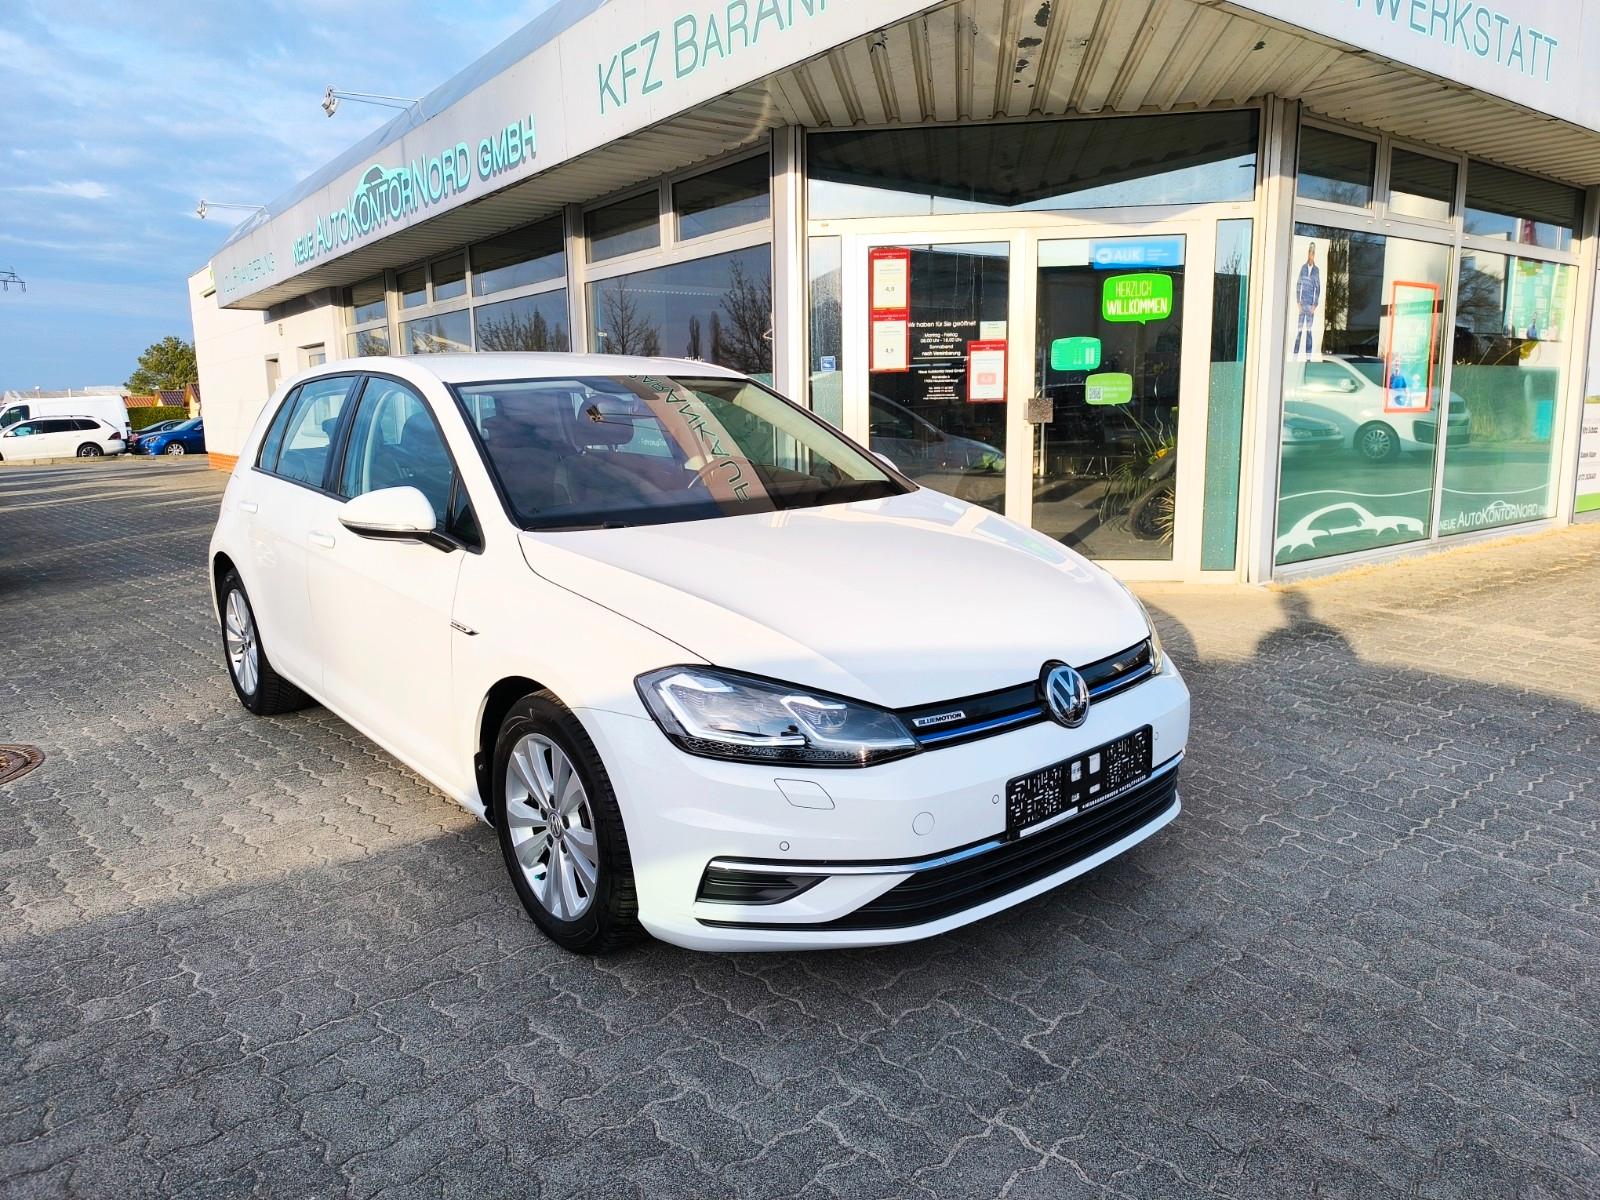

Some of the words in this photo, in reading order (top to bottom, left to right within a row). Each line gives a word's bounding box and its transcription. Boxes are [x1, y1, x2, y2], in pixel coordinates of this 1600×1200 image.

[597, 29, 664, 116] KFZ
[291, 231, 315, 266] NEUE
[1115, 279, 1152, 297] HERZLICH
[1106, 297, 1168, 316] WILLKOMMEN
[953, 320, 976, 328] geöffnet
[918, 712, 962, 725] BLUEMOTION
